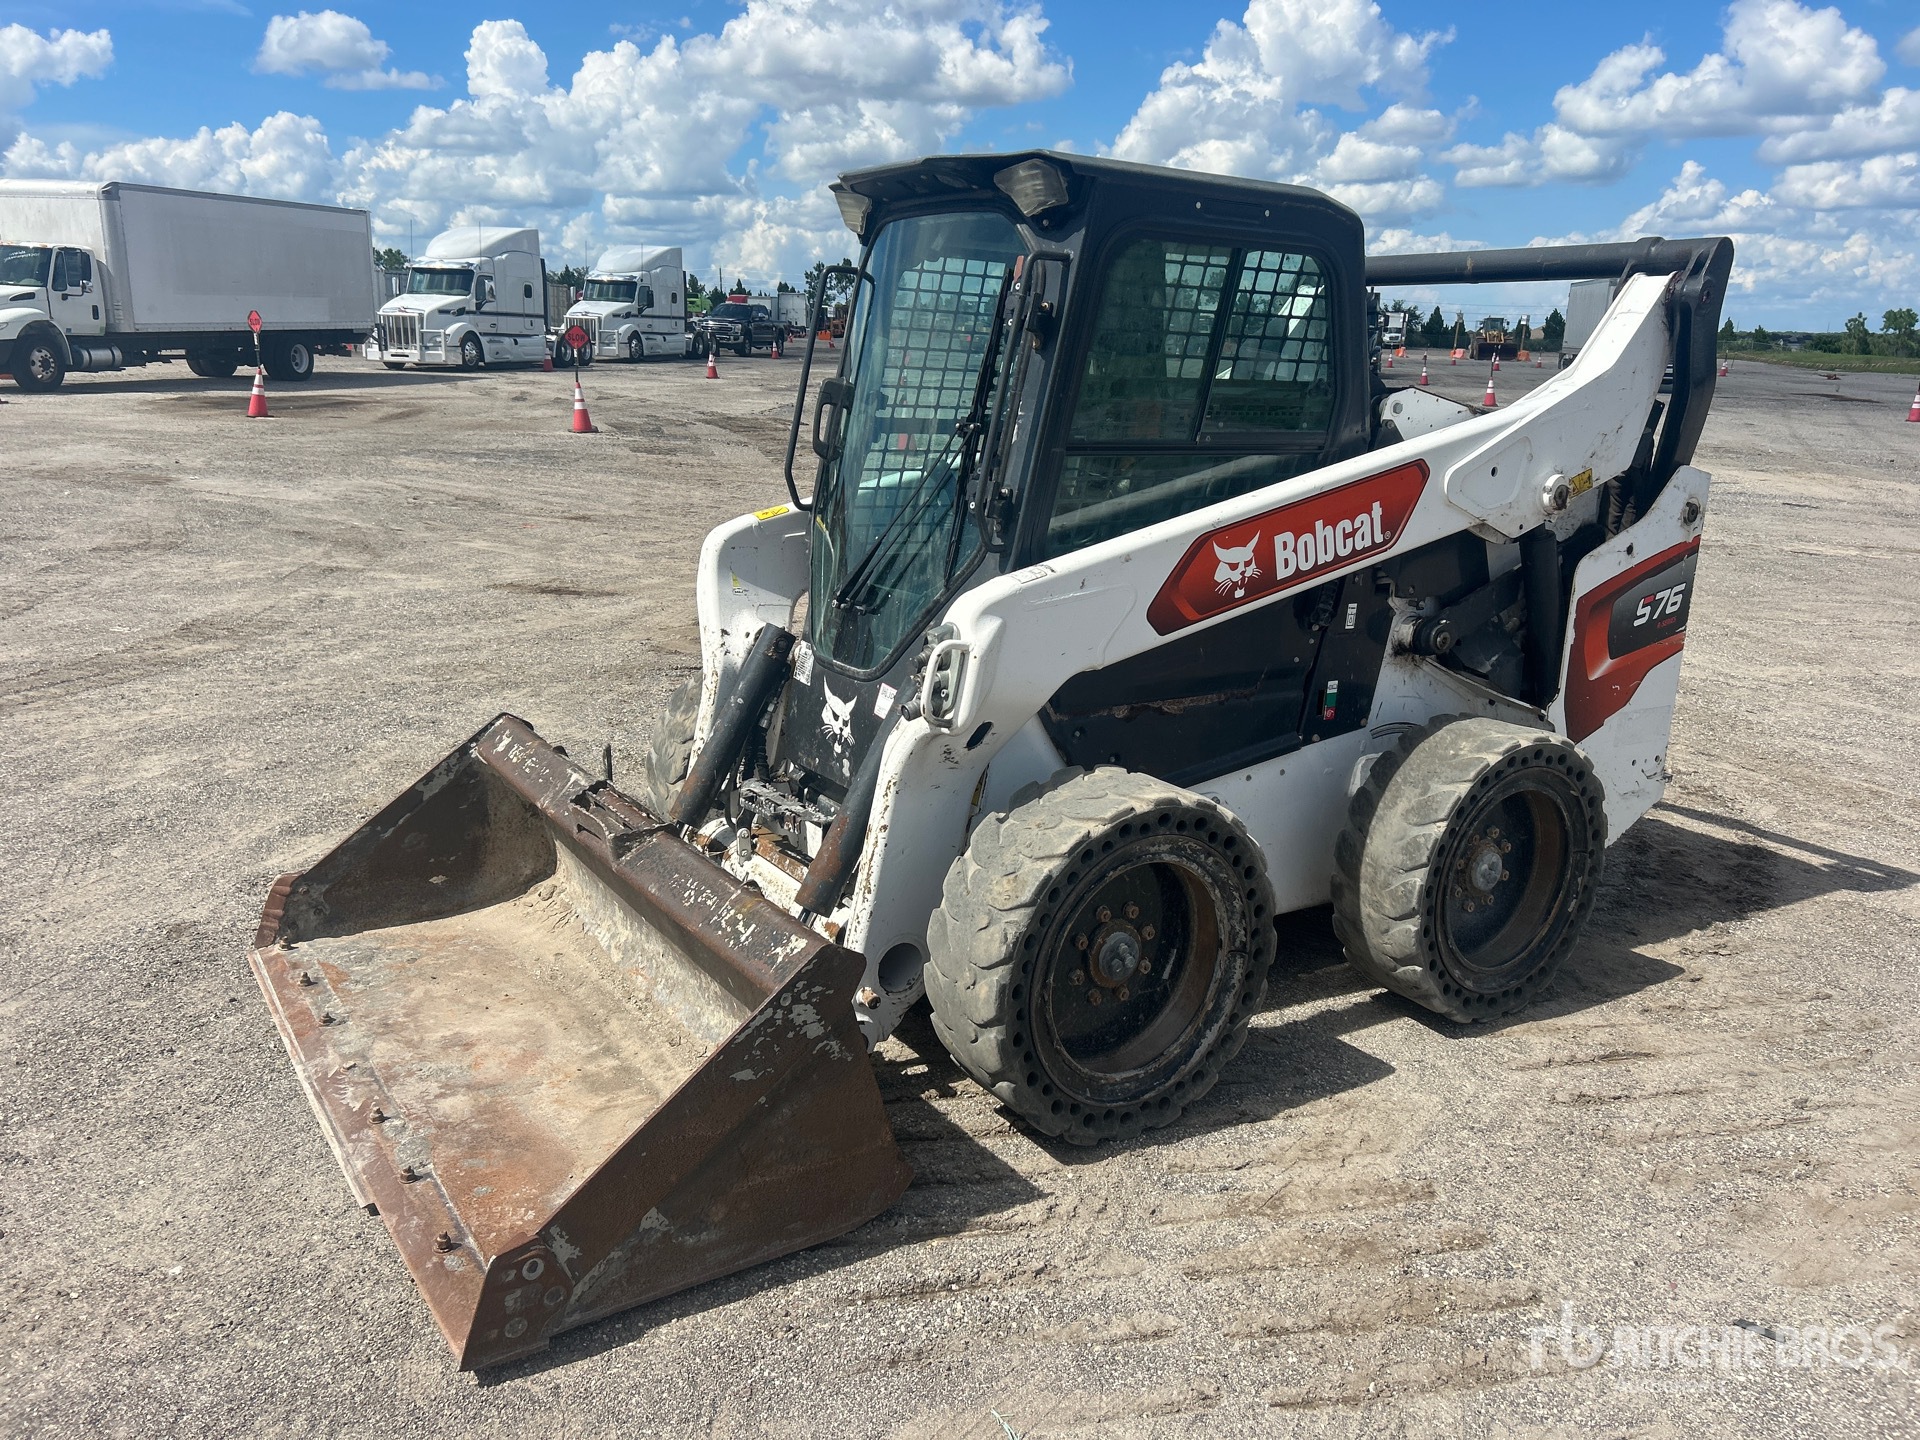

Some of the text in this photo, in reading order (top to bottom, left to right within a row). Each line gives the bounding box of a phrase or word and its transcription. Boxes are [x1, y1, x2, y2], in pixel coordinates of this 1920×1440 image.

[567, 333, 586, 341] SLOW
[1273, 500, 1384, 581] Bobcat
[1633, 582, 1687, 627] S76
